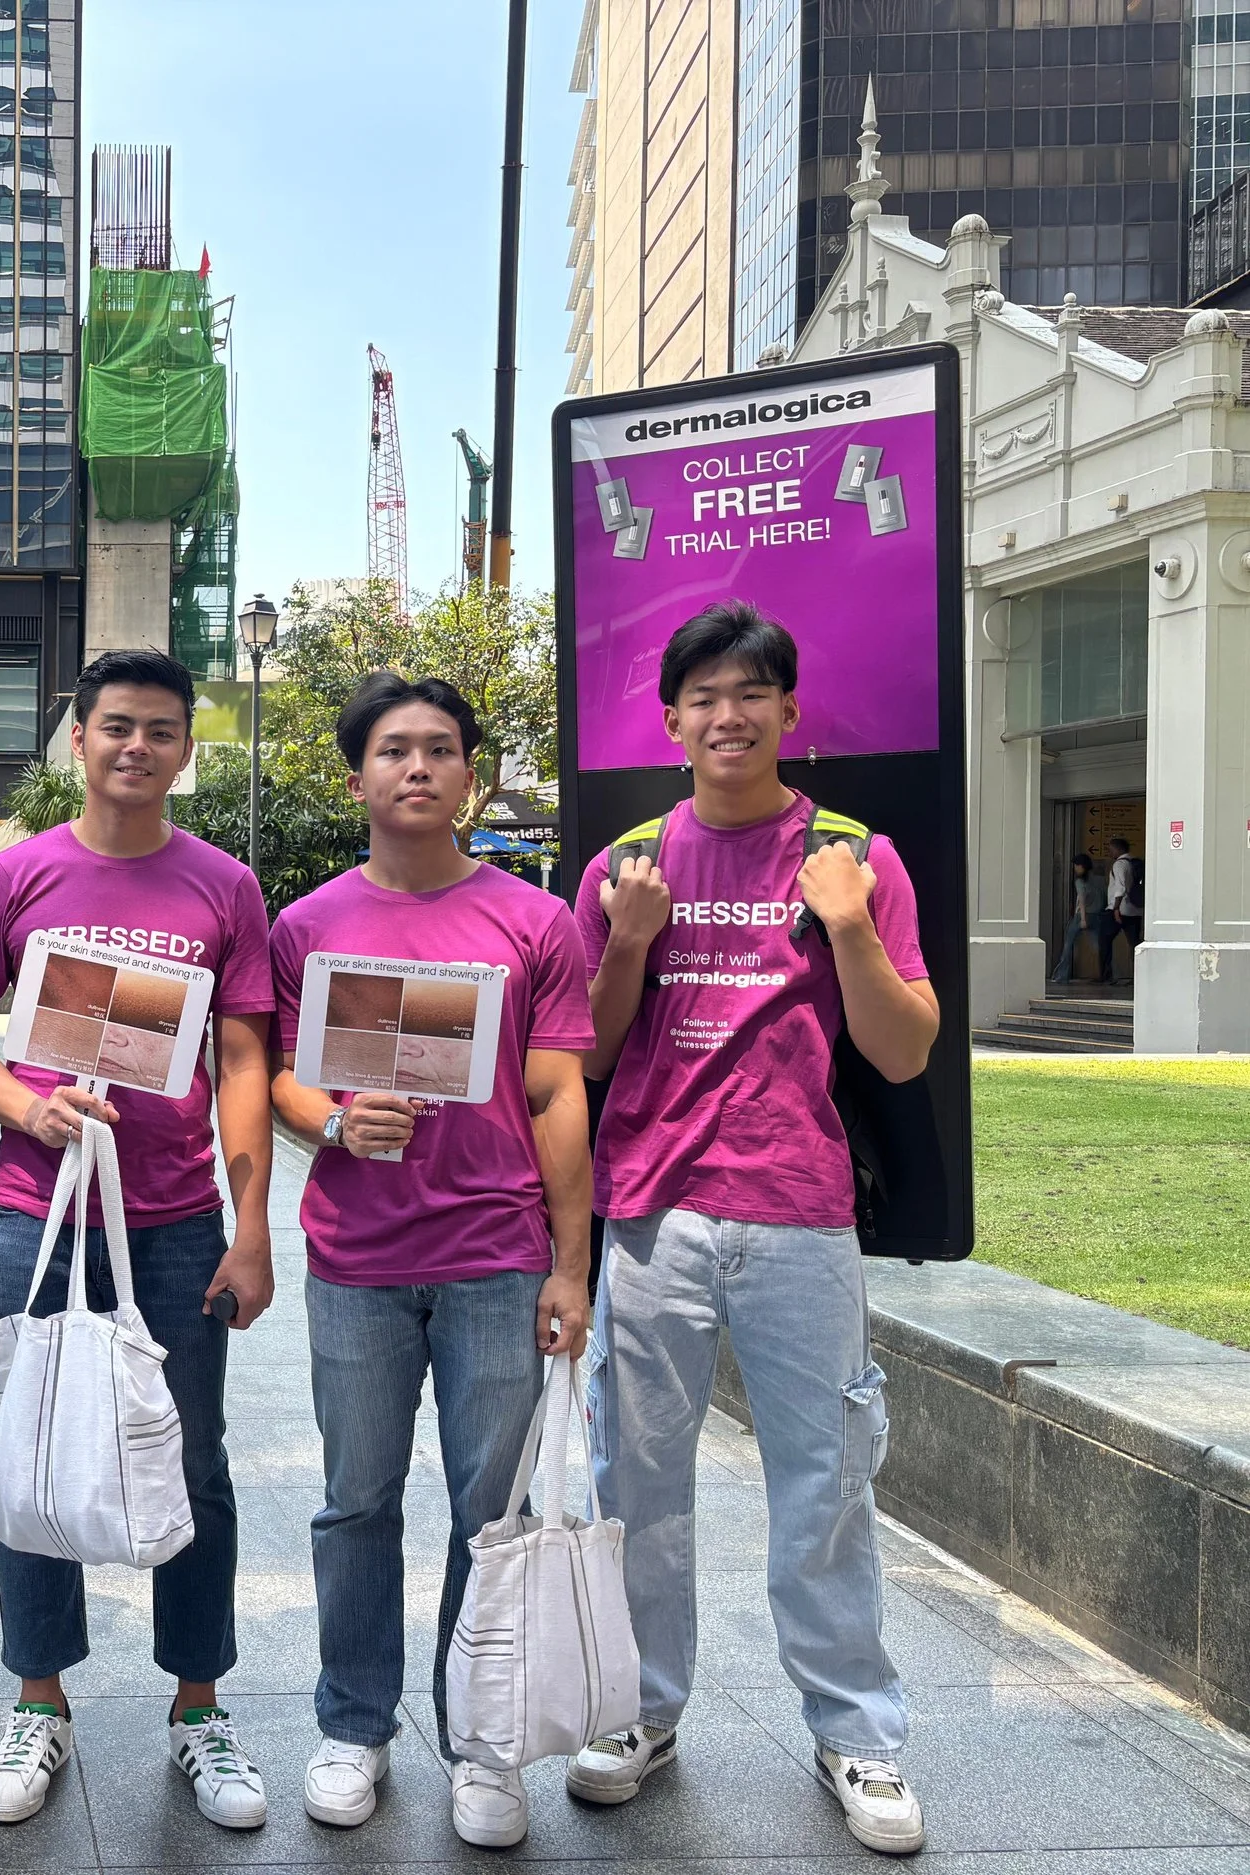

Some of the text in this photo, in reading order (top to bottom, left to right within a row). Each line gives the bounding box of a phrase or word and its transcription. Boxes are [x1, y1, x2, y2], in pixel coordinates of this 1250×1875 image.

[625, 390, 871, 442] dermalogica
[683, 446, 810, 483] COLLECT
[693, 479, 801, 521] FREE
[665, 518, 830, 556] TRIAL HERE!
[672, 901, 805, 926] RESSED?
[37, 936, 204, 982] Is your skin stressed and showing it?
[317, 956, 326, 966] Is
[328, 959, 350, 970] your
[352, 960, 372, 971] skin
[374, 962, 416, 974] stressed
[417, 965, 437, 976] and
[439, 967, 479, 982] showing
[482, 971, 494, 981] it?
[668, 950, 761, 967] Solve it with
[658, 971, 786, 988] ermalogica
[683, 1019, 728, 1028] Follow us
